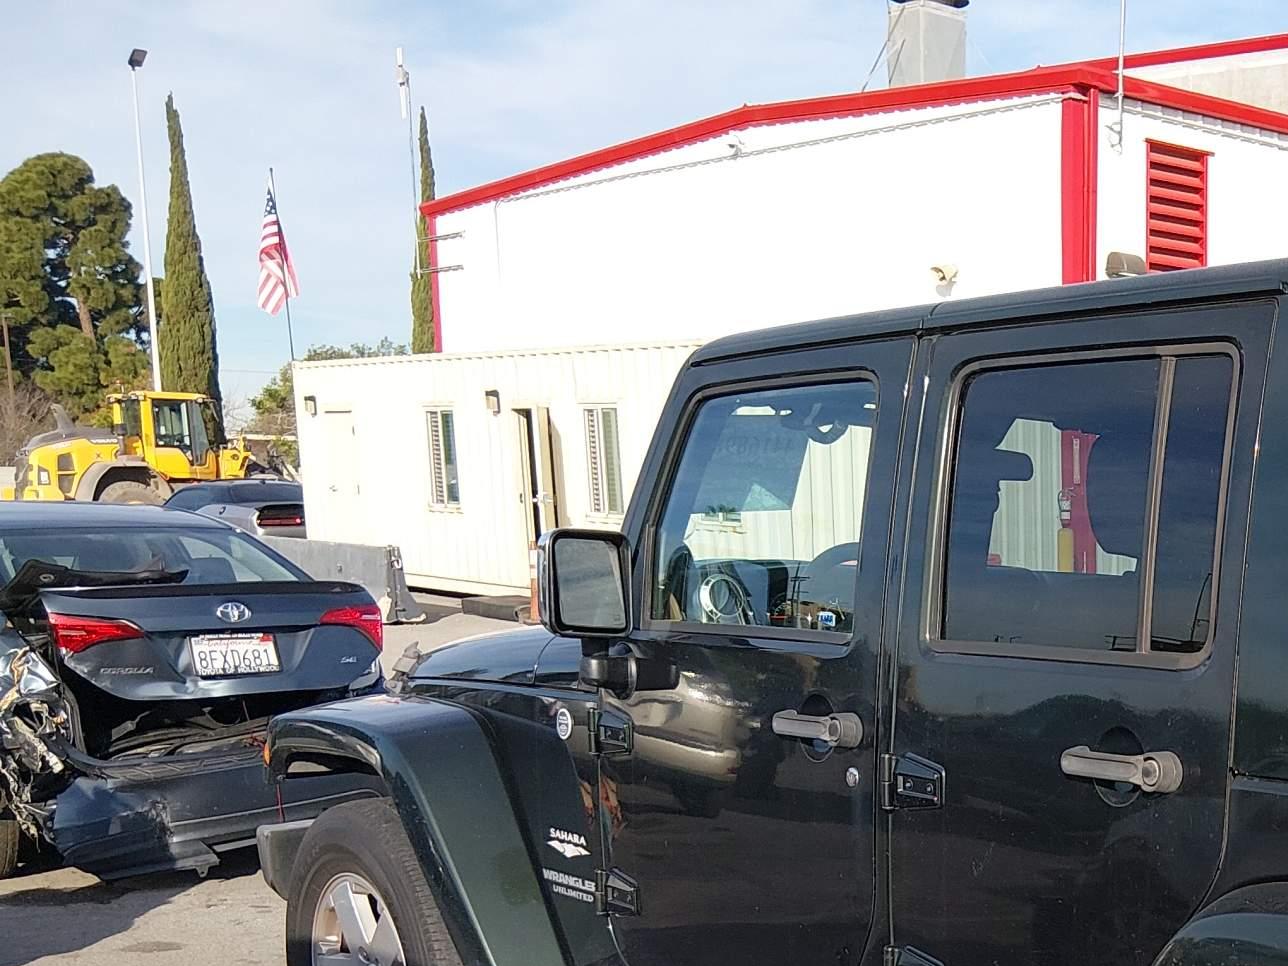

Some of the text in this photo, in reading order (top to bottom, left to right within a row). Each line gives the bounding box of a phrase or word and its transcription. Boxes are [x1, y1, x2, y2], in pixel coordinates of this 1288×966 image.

[198, 648, 272, 671] 8FXD681
[549, 827, 588, 846] SAHARA
[552, 884, 594, 902] UNLIMITED
